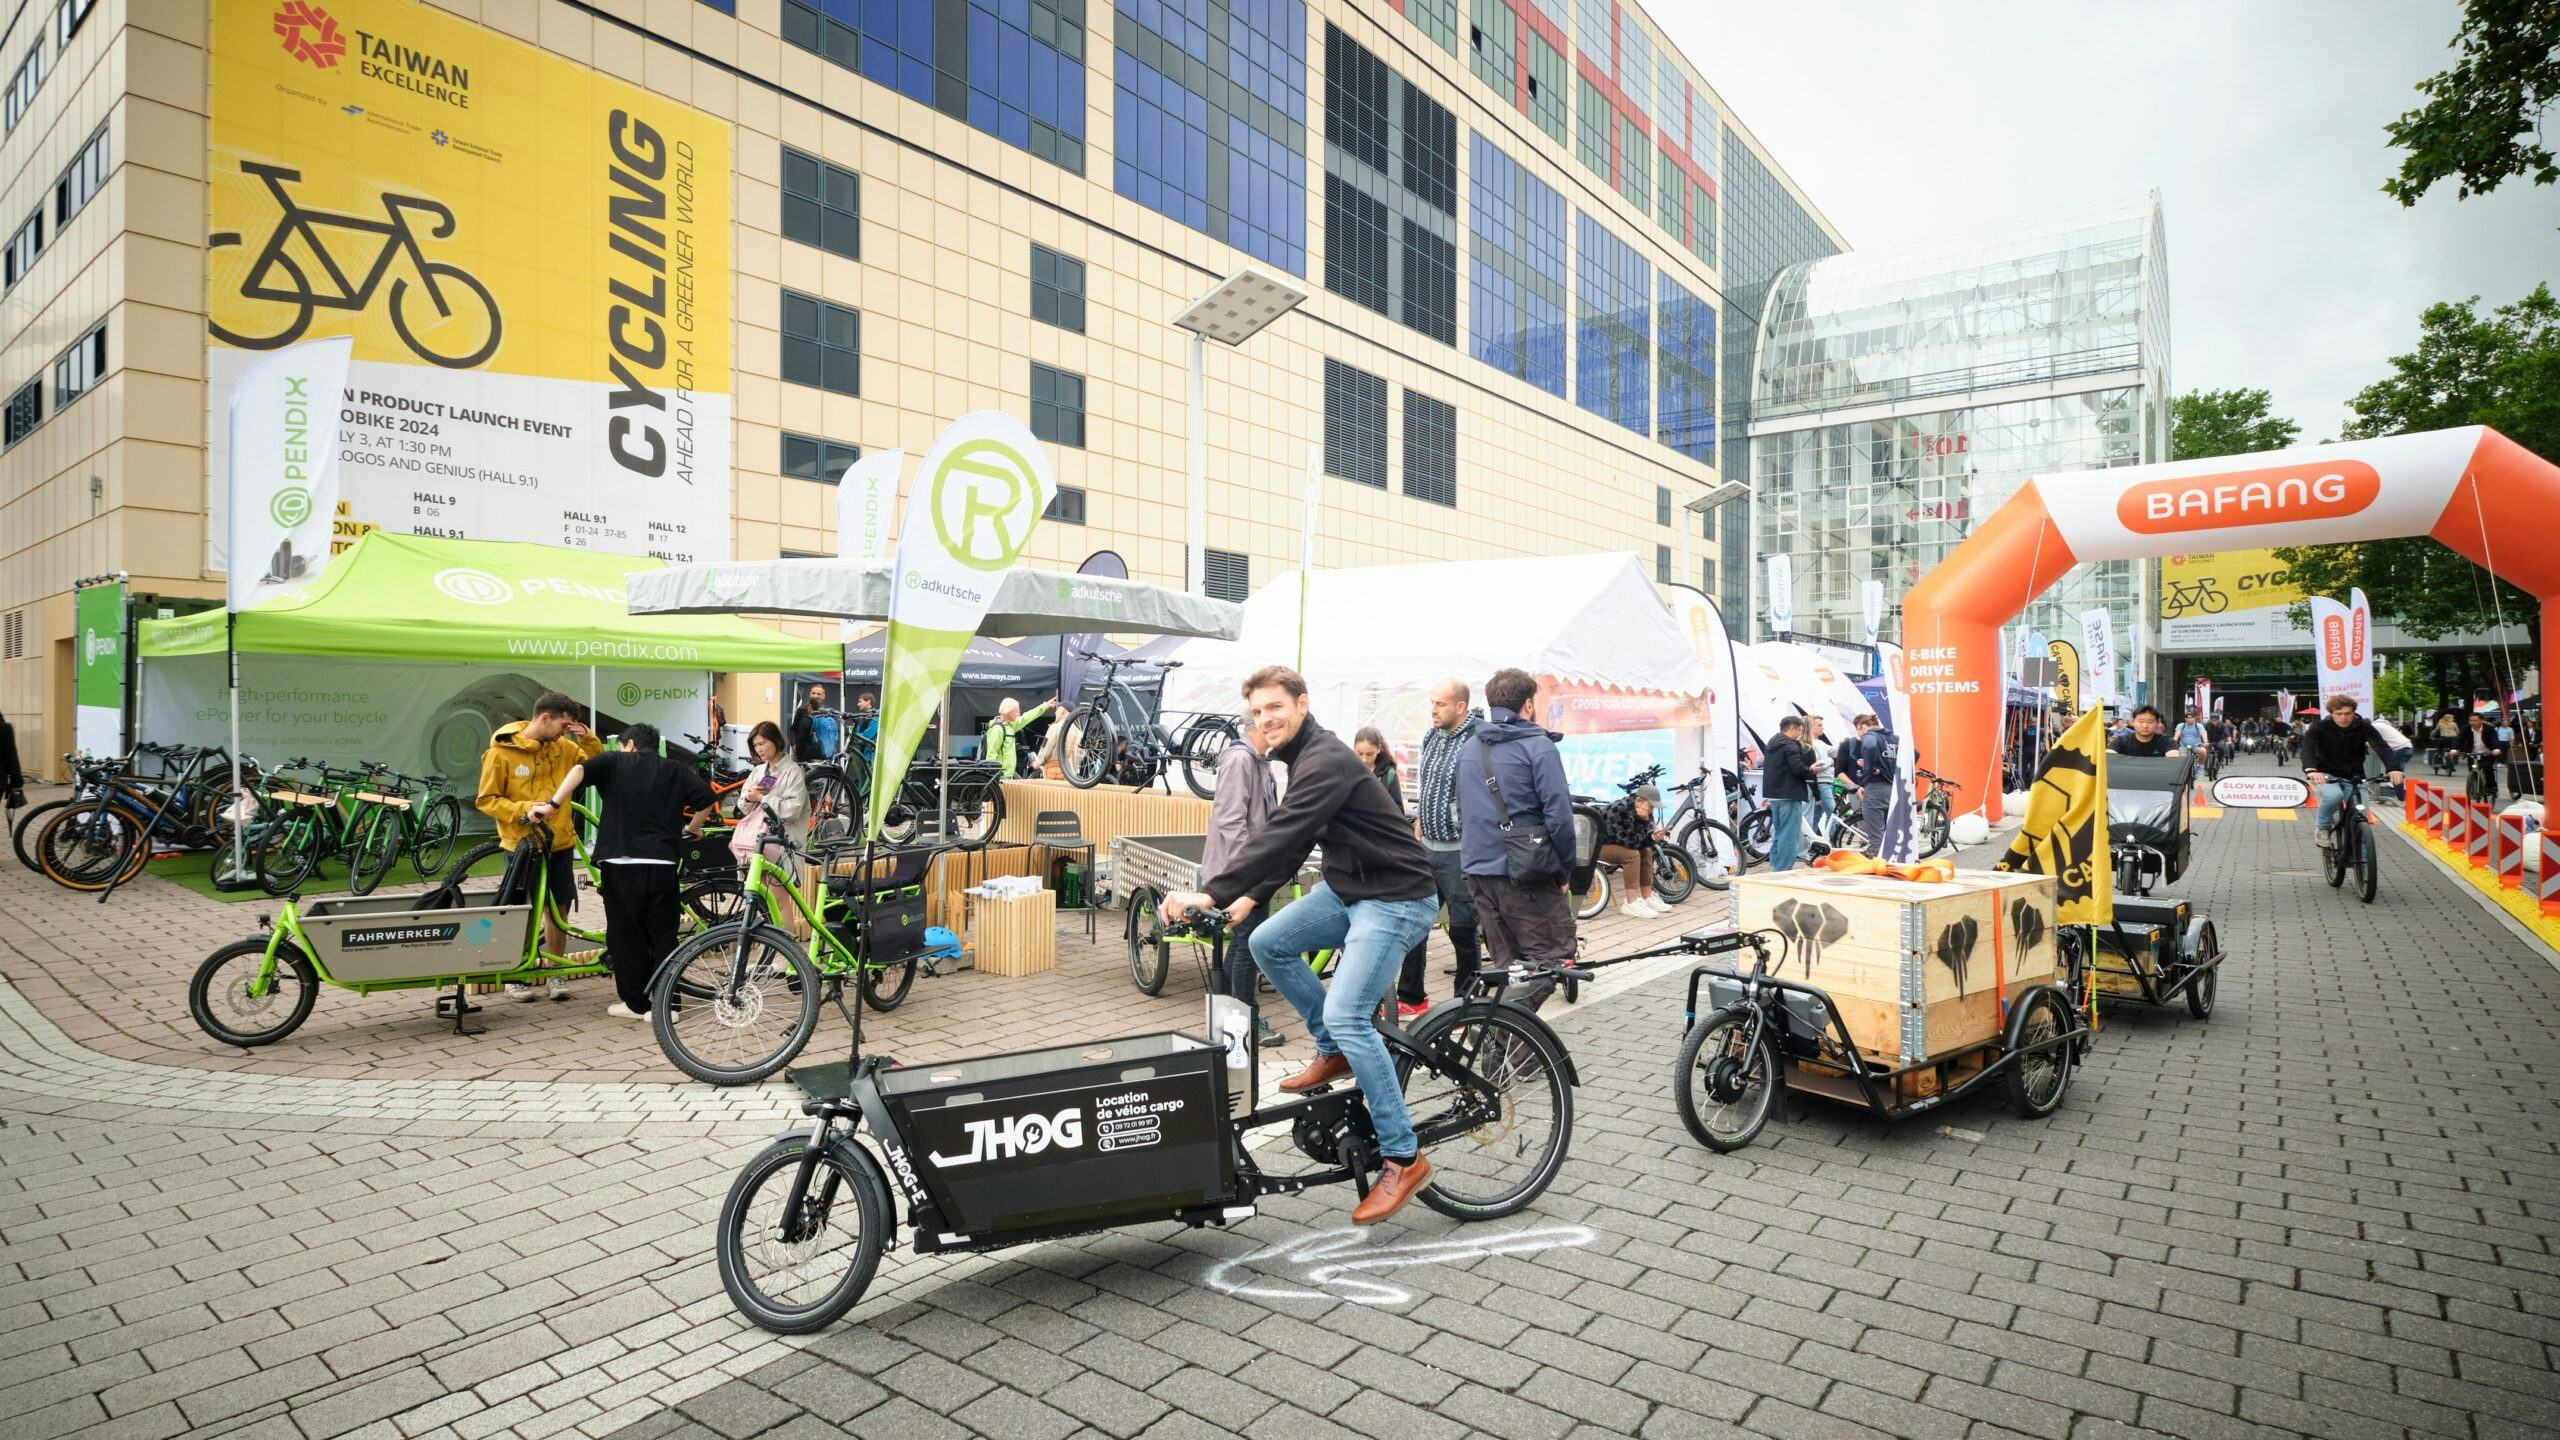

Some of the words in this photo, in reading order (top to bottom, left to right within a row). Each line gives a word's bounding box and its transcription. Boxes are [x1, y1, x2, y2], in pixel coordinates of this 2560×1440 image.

[355, 30, 469, 90] TAIWAN
[275, 84, 316, 103] Organized
[361, 60, 469, 109] EXCELLENCE
[677, 141, 694, 224] WORLD
[677, 230, 694, 332] GREENER
[608, 109, 667, 478] CYCLING
[677, 340, 694, 356] A
[677, 359, 694, 404] FOR
[340, 408, 394, 430] OBIKE
[400, 418, 440, 437] 2024
[360, 390, 445, 418] PRODUCT
[450, 406, 519, 430] LAUNCH
[523, 419, 573, 439] EVENT
[285, 376, 308, 480] PENDIX
[339, 430, 356, 444] LY
[359, 433, 372, 448] 3,
[376, 436, 394, 450] AT
[399, 439, 426, 454] 1:30
[430, 444, 452, 458] PM
[677, 408, 694, 486] AHEAD
[338, 449, 386, 467] OGOS
[389, 456, 421, 471] AND
[425, 461, 476, 479] GENIUS
[478, 468, 516, 486] (HALL
[519, 474, 539, 490] 9.1)
[413, 491, 446, 505] HALL
[449, 496, 456, 505] 9
[2147, 474, 2345, 520] BAFANG
[413, 506, 421, 515] B
[427, 506, 440, 517] 06
[563, 510, 591, 523] HALL
[593, 514, 607, 524] 9.1
[864, 476, 879, 550] PENDIX
[413, 525, 446, 538] HALL
[449, 529, 465, 539] 9.1
[648, 521, 674, 532] HALL
[675, 524, 687, 533] 12
[564, 536, 571, 544] G
[575, 537, 587, 546] 26
[648, 550, 674, 561] HALL
[675, 553, 693, 563] 12.1
[708, 569, 760, 588] adkutsche
[2237, 570, 2287, 591] CYC
[519, 578, 627, 605] PEND
[96, 637, 117, 655] PENDIX
[508, 638, 698, 662] www.pendix.com
[2329, 621, 2342, 665] BAFANG
[1910, 647, 1957, 661] E-BIKE
[1910, 665, 1954, 677] DRIVE
[218, 686, 369, 705] Hgh-performance
[644, 687, 698, 700] PENDIX
[1910, 681, 1980, 694] SYSTEMS
[1572, 698, 1600, 711] CROSS
[266, 709, 287, 724] for
[292, 712, 329, 727] your
[333, 707, 388, 727] bicycle
[2258, 783, 2298, 791] PLEASE
[349, 928, 441, 943] FAHRWERKER
[1096, 1092, 1149, 1108] Location
[1096, 1108, 1113, 1120] de
[1115, 1104, 1147, 1117] vélos
[1149, 1099, 1185, 1112] cargo
[929, 1107, 1083, 1168] JHOG
[1118, 1133, 1157, 1145] www.jhog.fr
[883, 1138, 928, 1206] JHOG-E
